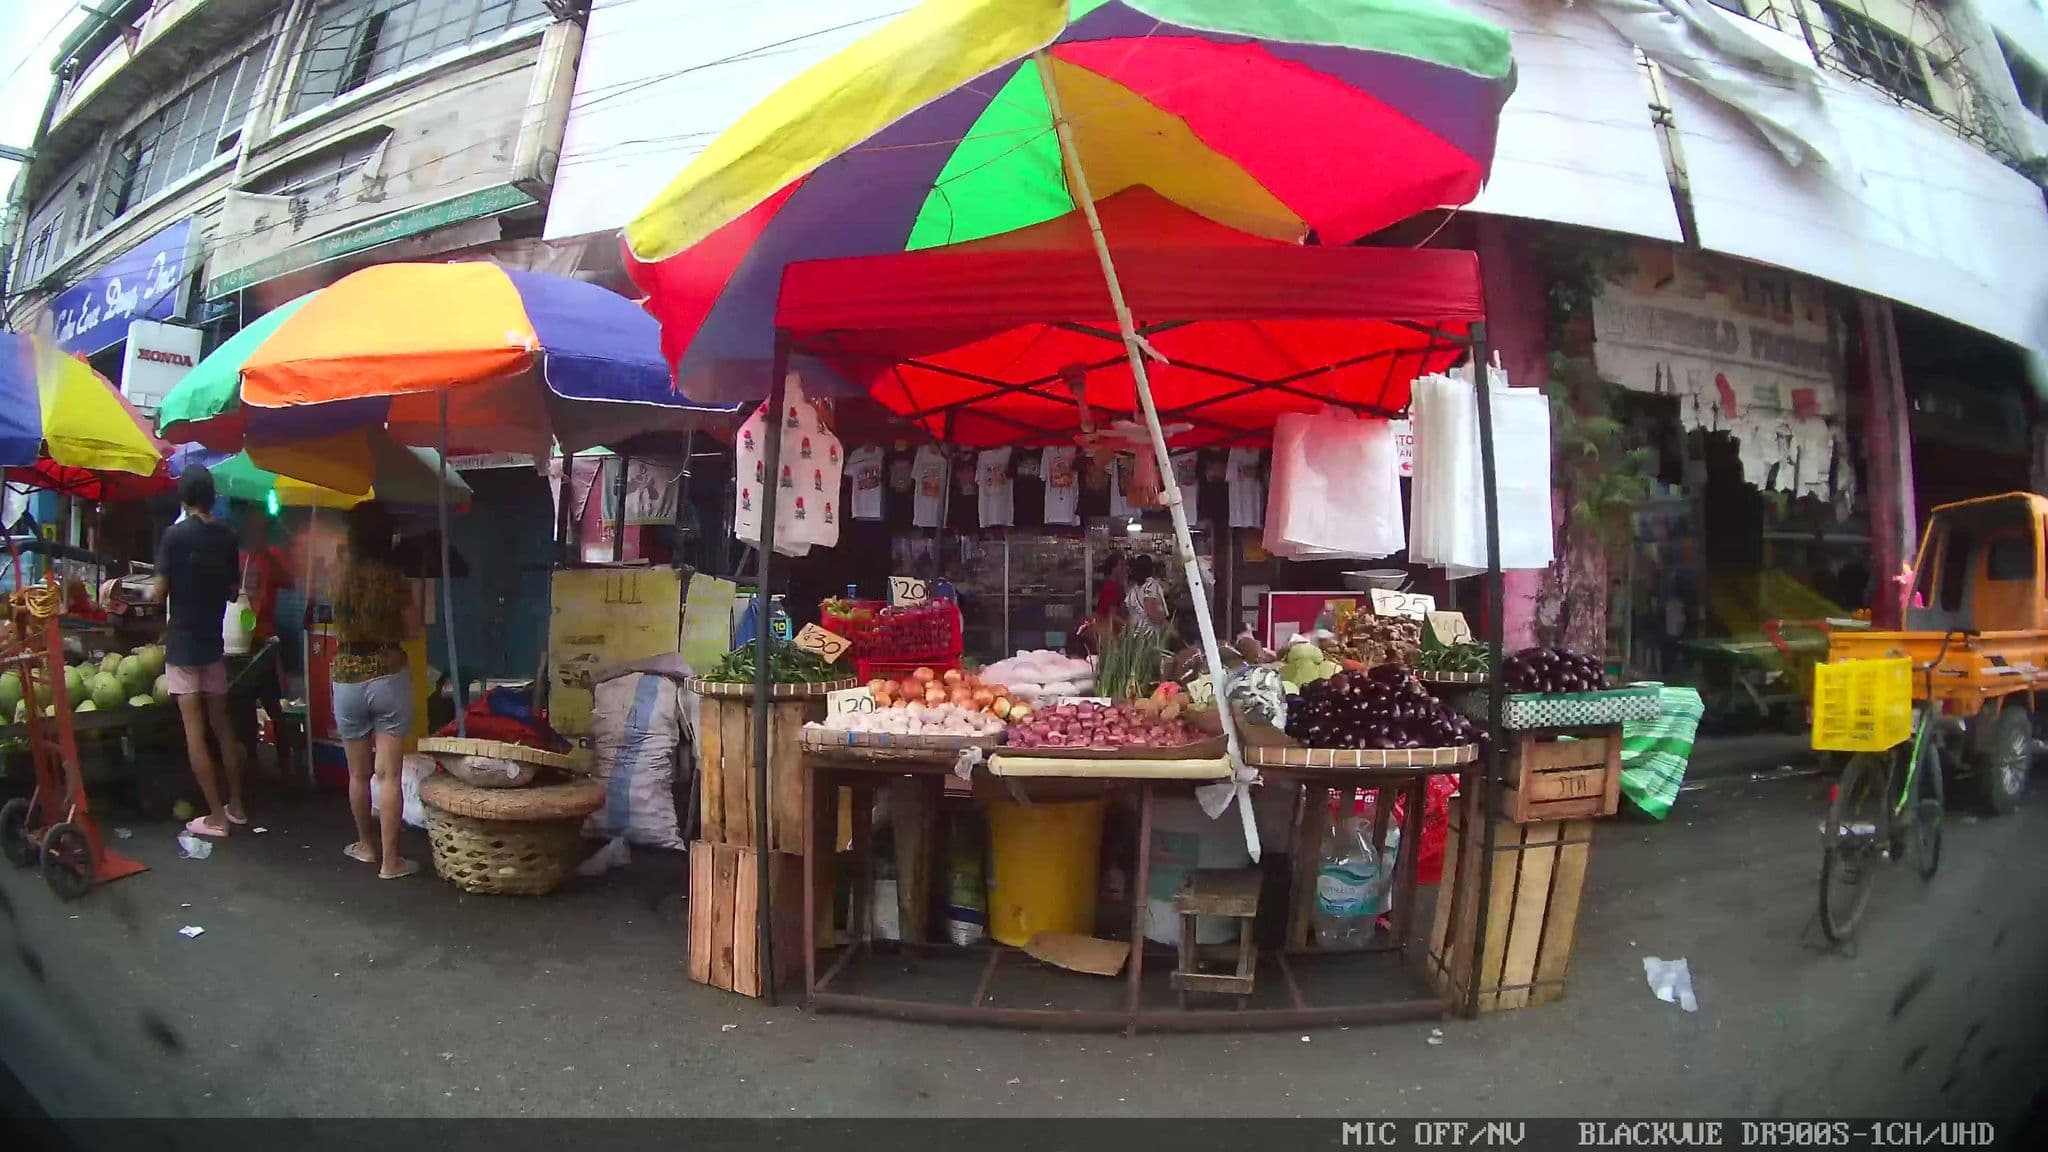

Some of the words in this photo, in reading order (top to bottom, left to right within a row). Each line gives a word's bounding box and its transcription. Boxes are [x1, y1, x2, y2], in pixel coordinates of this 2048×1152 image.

[137, 348, 193, 367] HONDA
[898, 581, 926, 600] 20
[774, 622, 786, 631] 10
[805, 633, 842, 654] 30
[838, 695, 874, 714] 120
